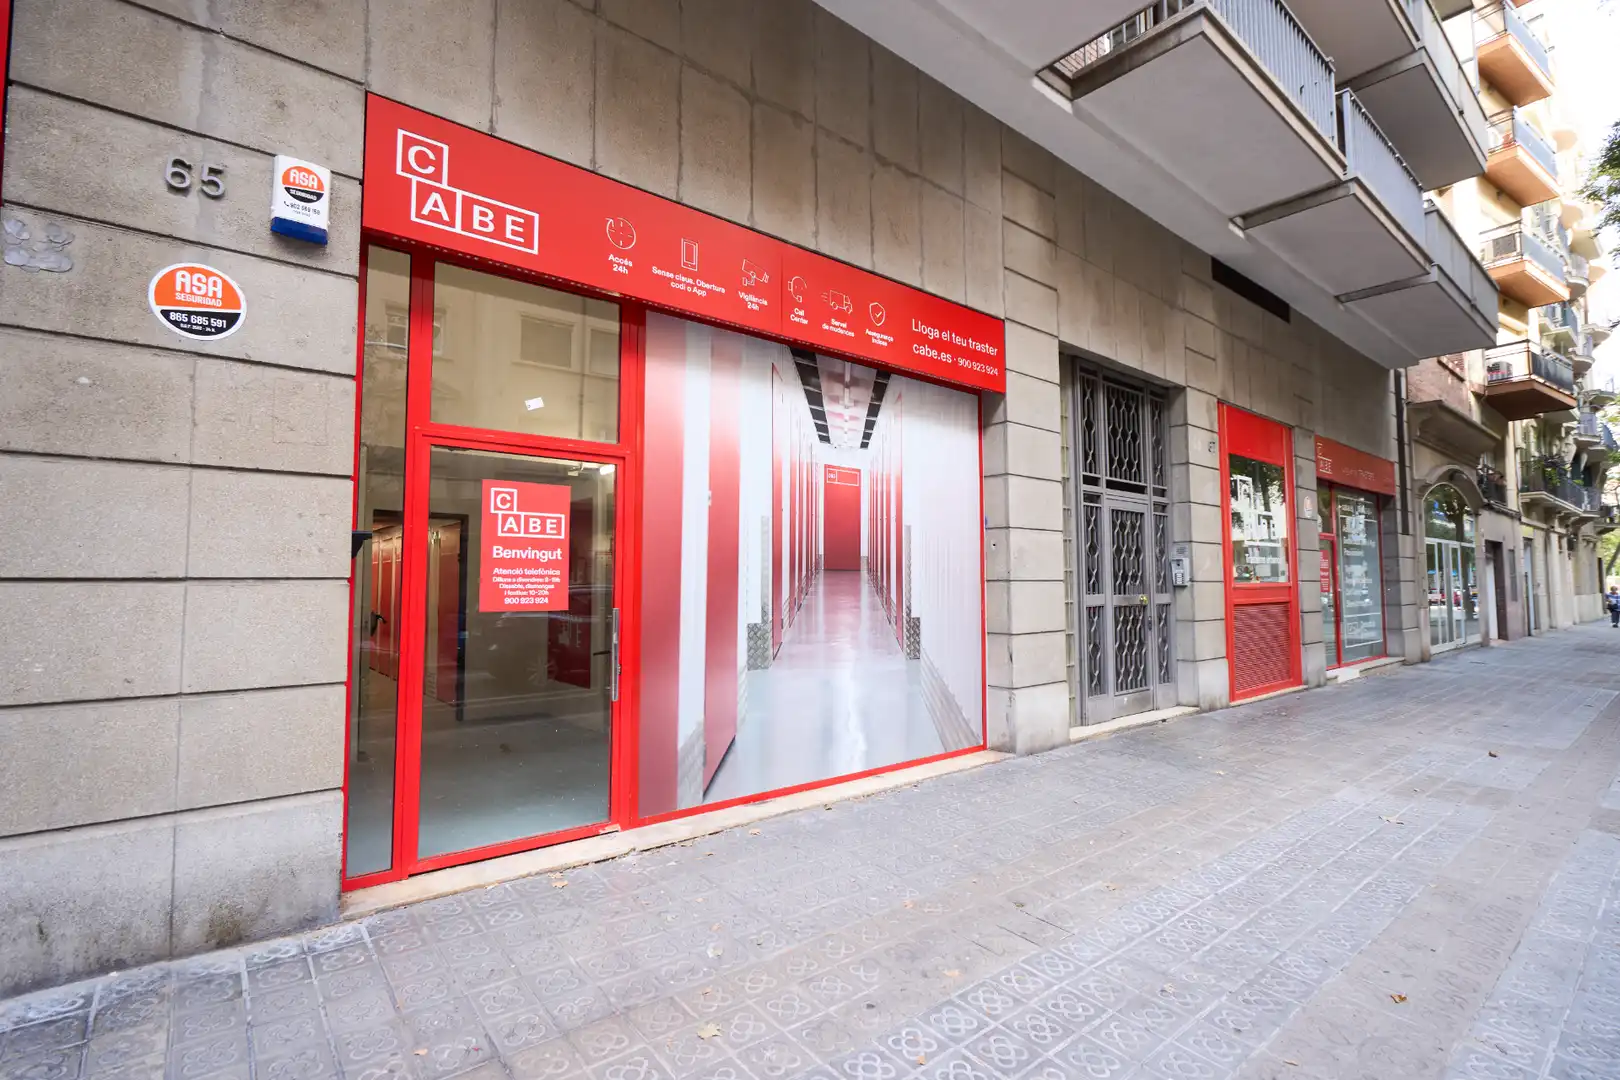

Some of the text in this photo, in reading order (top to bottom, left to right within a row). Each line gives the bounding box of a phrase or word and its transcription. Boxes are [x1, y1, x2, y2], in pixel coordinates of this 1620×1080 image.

[165, 158, 227, 199] 65
[289, 168, 318, 189] ASA
[608, 252, 633, 267] Accés
[612, 263, 629, 275] 24h
[175, 270, 223, 299] ASA
[651, 265, 674, 279] Sense
[696, 278, 726, 294] Obertura
[670, 280, 686, 291] codi
[692, 286, 707, 298] App
[175, 292, 222, 307] SEGURIDAD
[747, 301, 760, 312] 24h
[169, 312, 227, 328] 865 685 591
[789, 313, 809, 325] Center
[793, 307, 805, 317] Call
[911, 318, 998, 356] Lloga el teu traster
[912, 342, 952, 364] cabe.es
[957, 357, 972, 370] 900
[972, 360, 986, 374] 923
[986, 363, 999, 376] 924
[493, 546, 562, 562] Benvingut
[493, 567, 561, 576] Atenció telefònica
[504, 597, 519, 605] 900
[520, 597, 535, 605] 923
